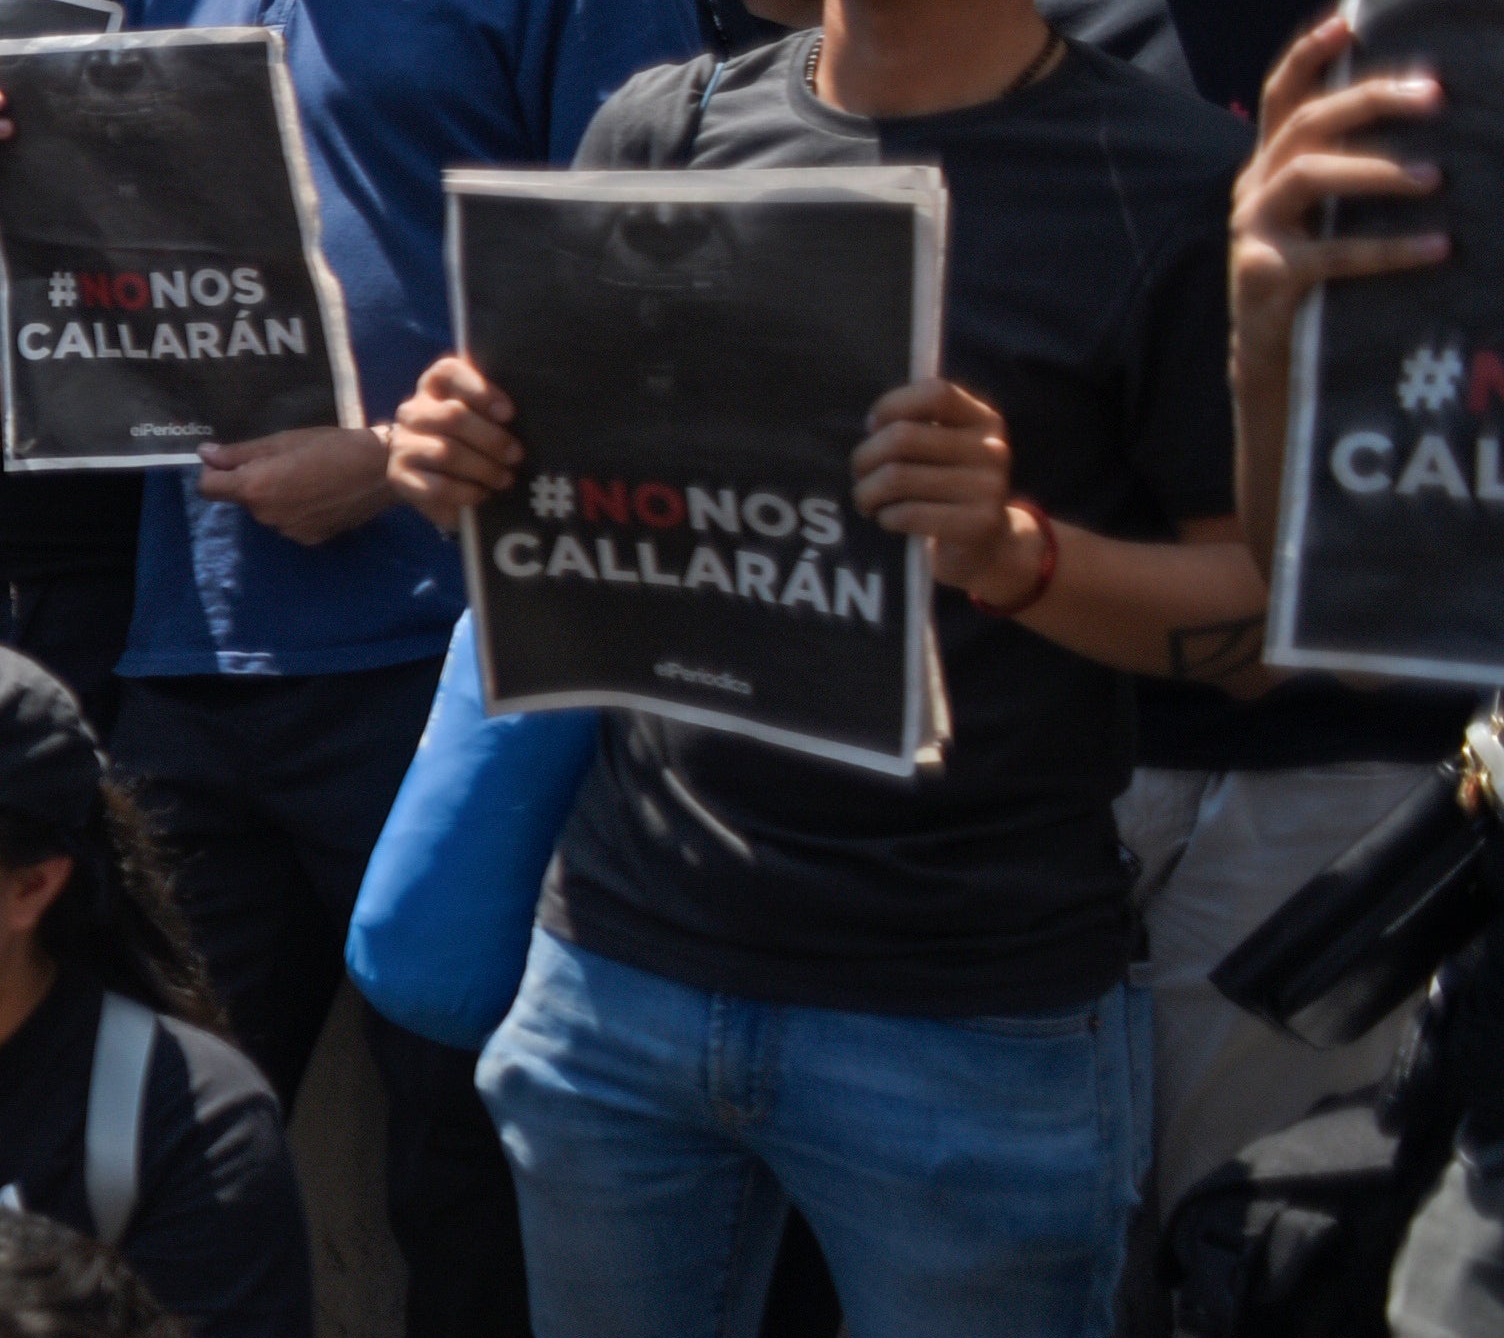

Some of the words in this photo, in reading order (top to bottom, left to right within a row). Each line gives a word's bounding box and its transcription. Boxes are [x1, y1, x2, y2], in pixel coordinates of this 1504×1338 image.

[47, 267, 265, 310] #NONOS
[17, 311, 308, 361] CALLARÁN
[130, 423, 213, 438] elPeriodico
[529, 473, 842, 546] #NONOS
[493, 533, 883, 624] CALLARÁN
